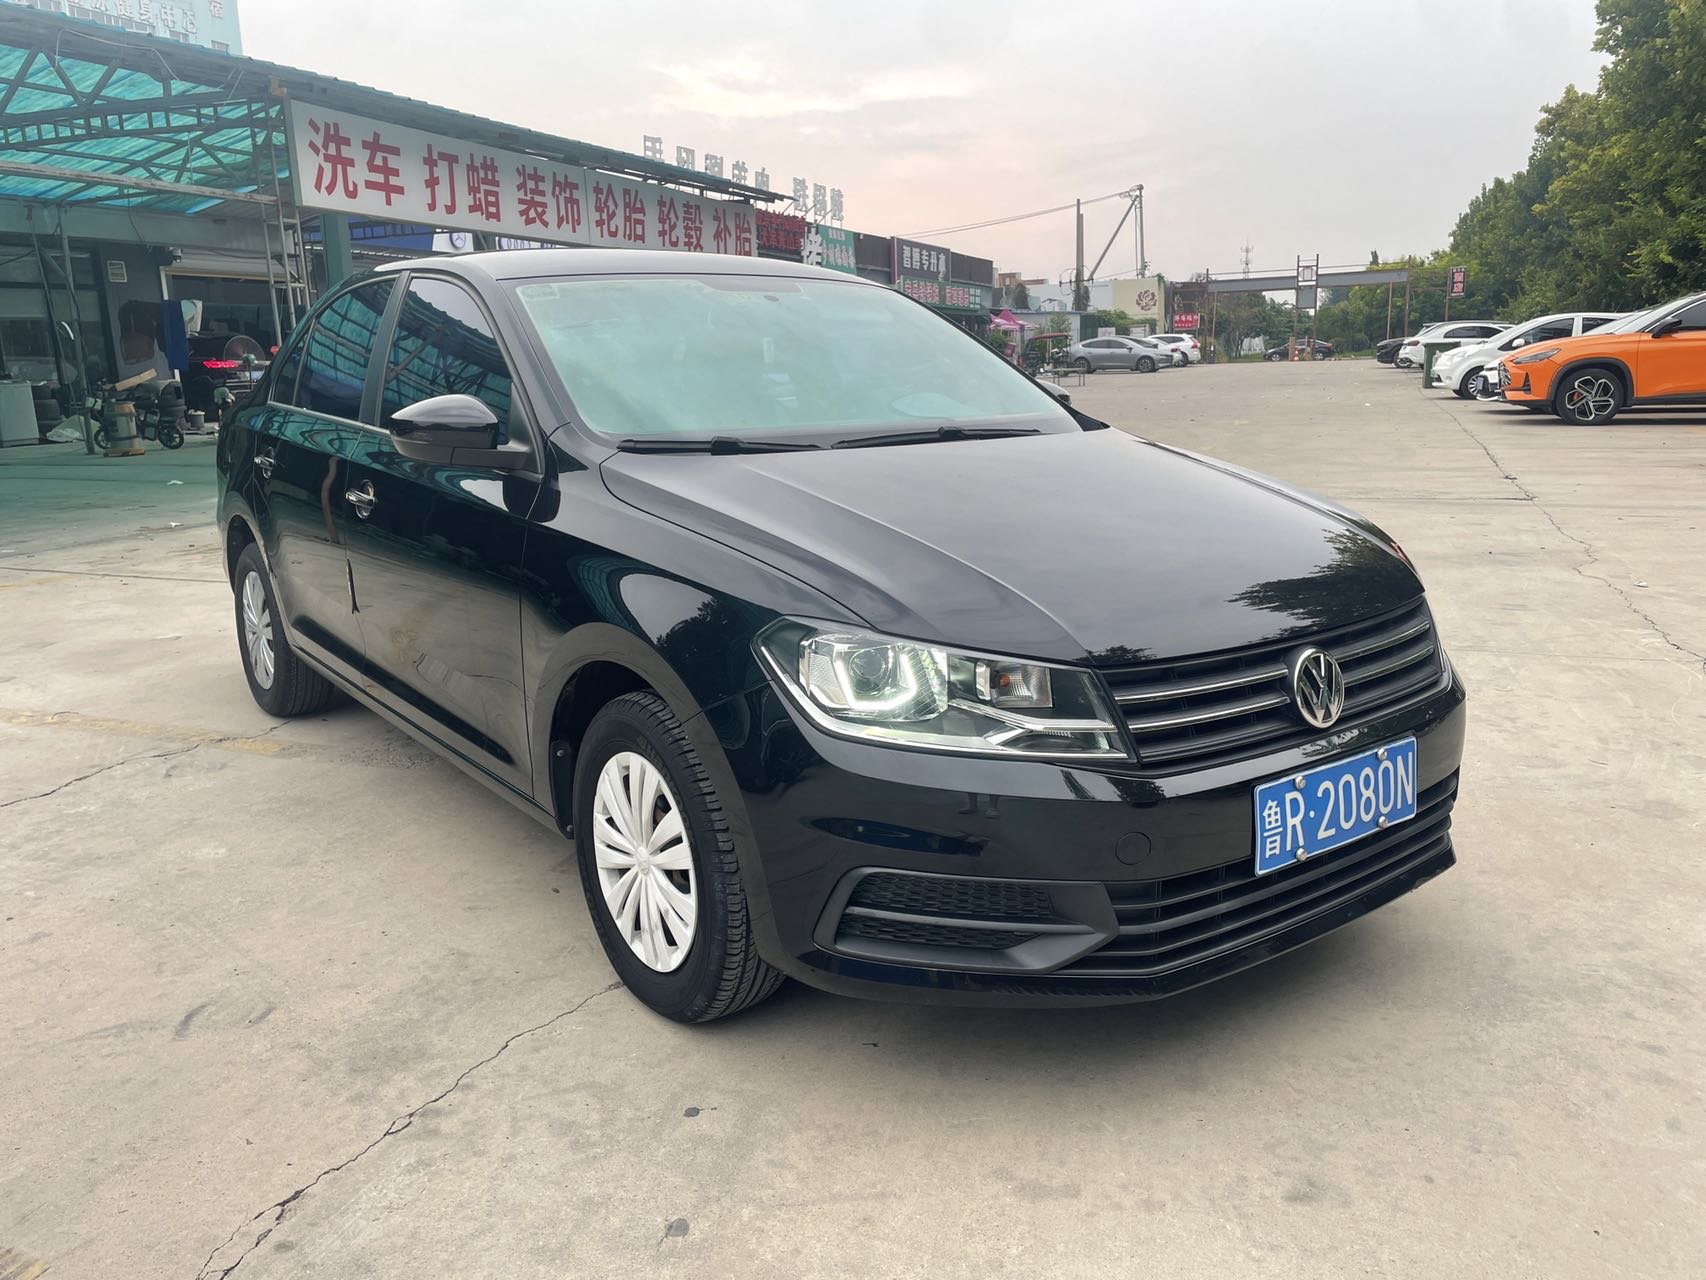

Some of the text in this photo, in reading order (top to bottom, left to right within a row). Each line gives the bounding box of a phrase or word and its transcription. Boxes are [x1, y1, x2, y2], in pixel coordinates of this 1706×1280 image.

[307, 118, 405, 207] 洗车
[422, 143, 502, 223] 打蜡
[515, 164, 582, 234] 装饰
[593, 180, 647, 245] 轮胎
[657, 195, 705, 253] 轮毂
[712, 208, 753, 258] 补胎
